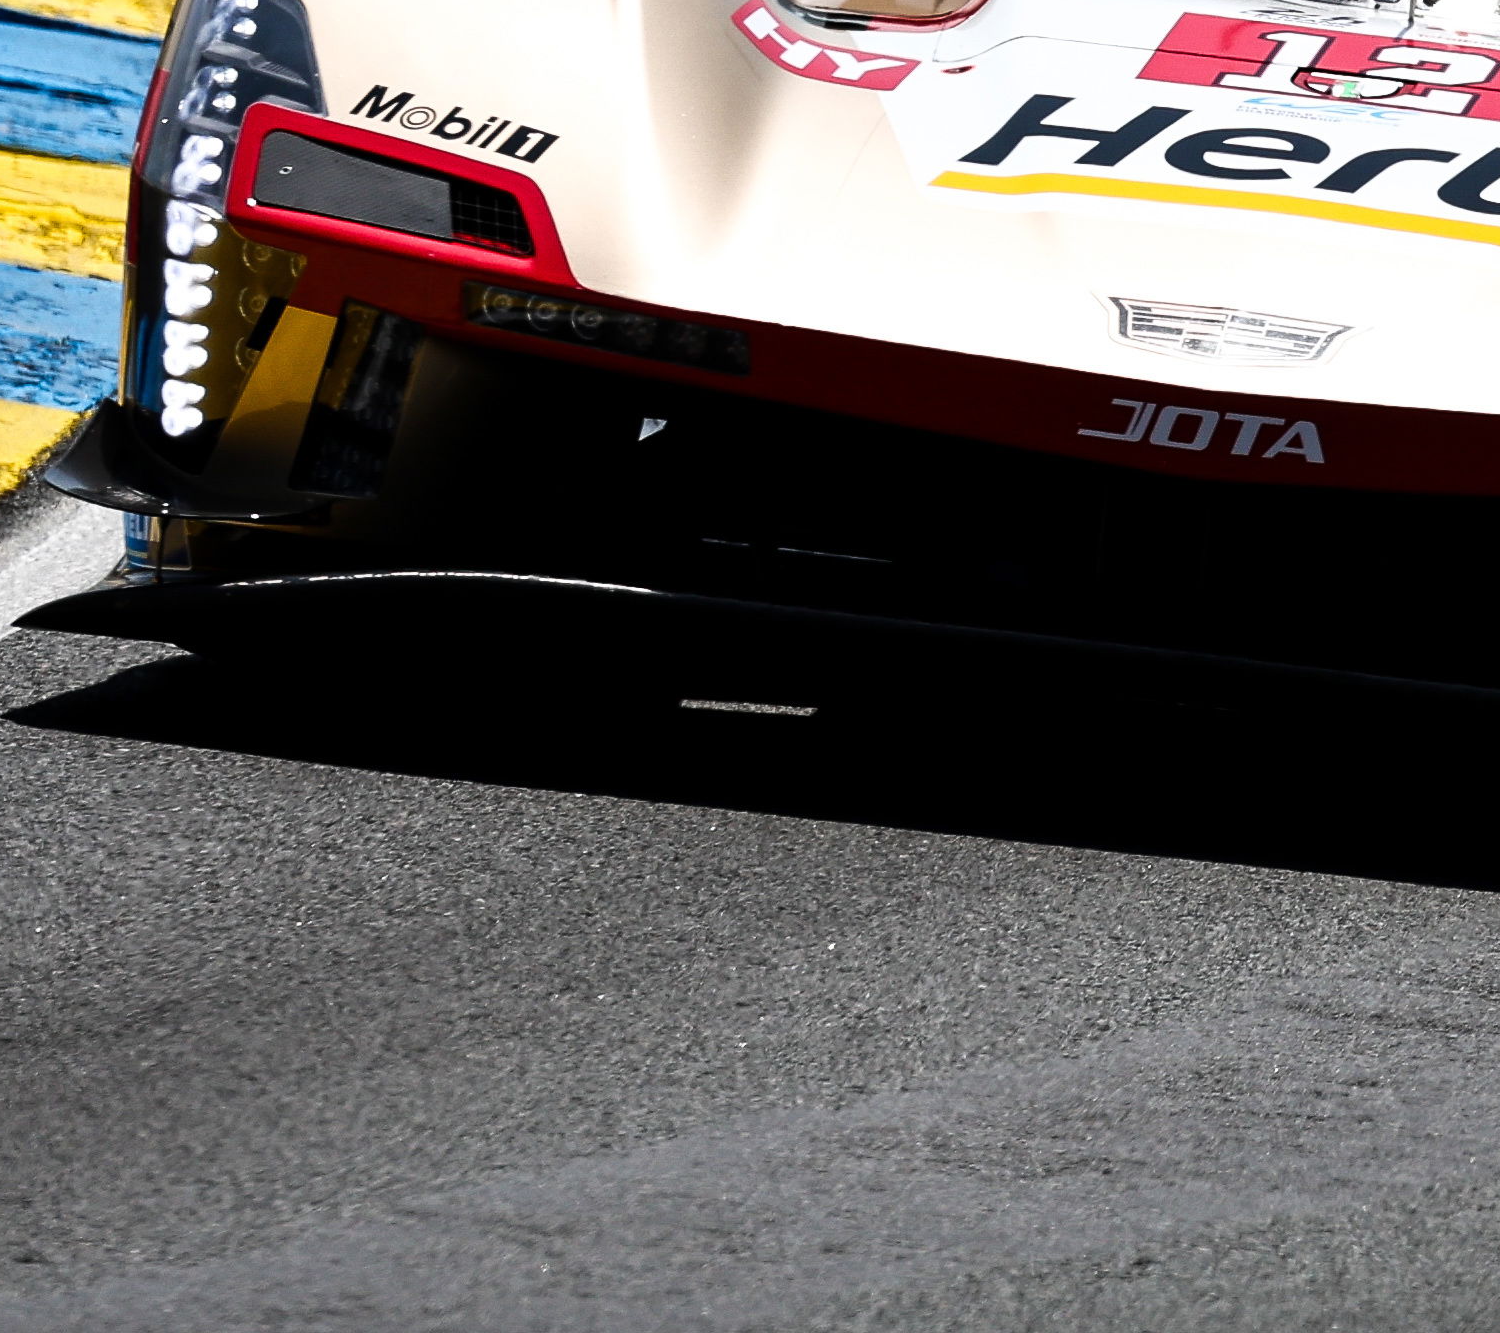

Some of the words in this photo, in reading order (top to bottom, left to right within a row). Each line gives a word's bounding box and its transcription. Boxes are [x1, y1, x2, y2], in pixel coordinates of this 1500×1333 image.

[742, 6, 908, 82] HY
[349, 84, 513, 150] Mobil
[1077, 397, 1326, 465] JOTA
